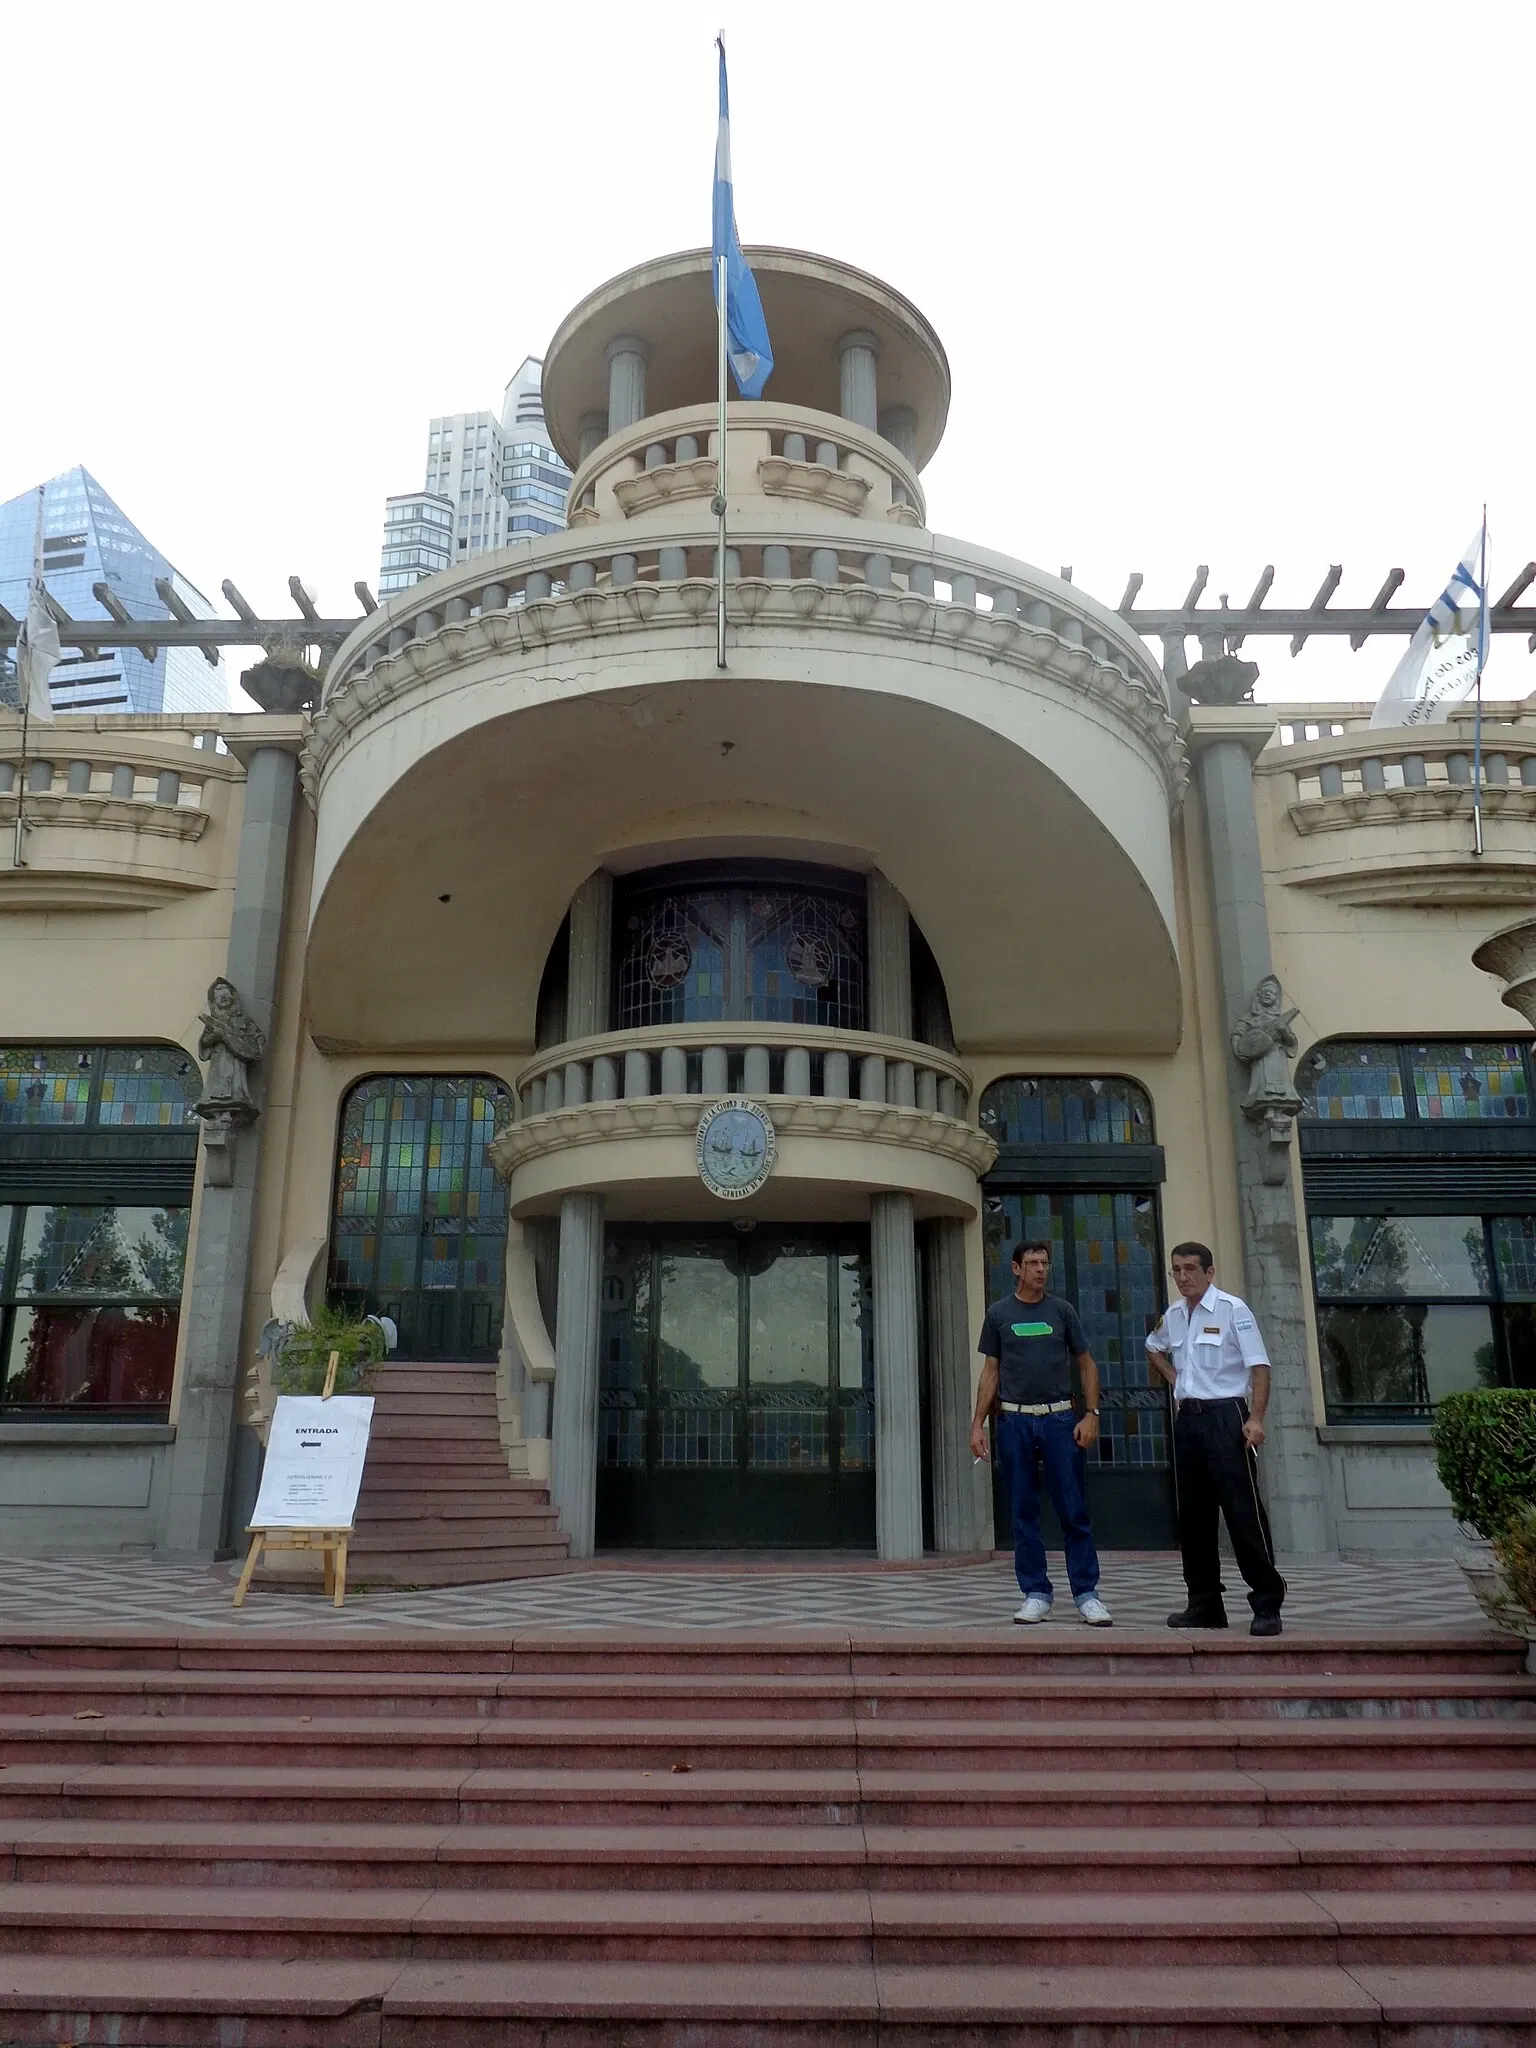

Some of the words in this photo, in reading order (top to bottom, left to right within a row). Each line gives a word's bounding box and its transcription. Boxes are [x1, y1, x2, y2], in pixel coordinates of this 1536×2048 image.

[716, 1100, 738, 1111] CIUDAD
[741, 1100, 749, 1109] DE
[722, 1187, 750, 1198] GENERAL
